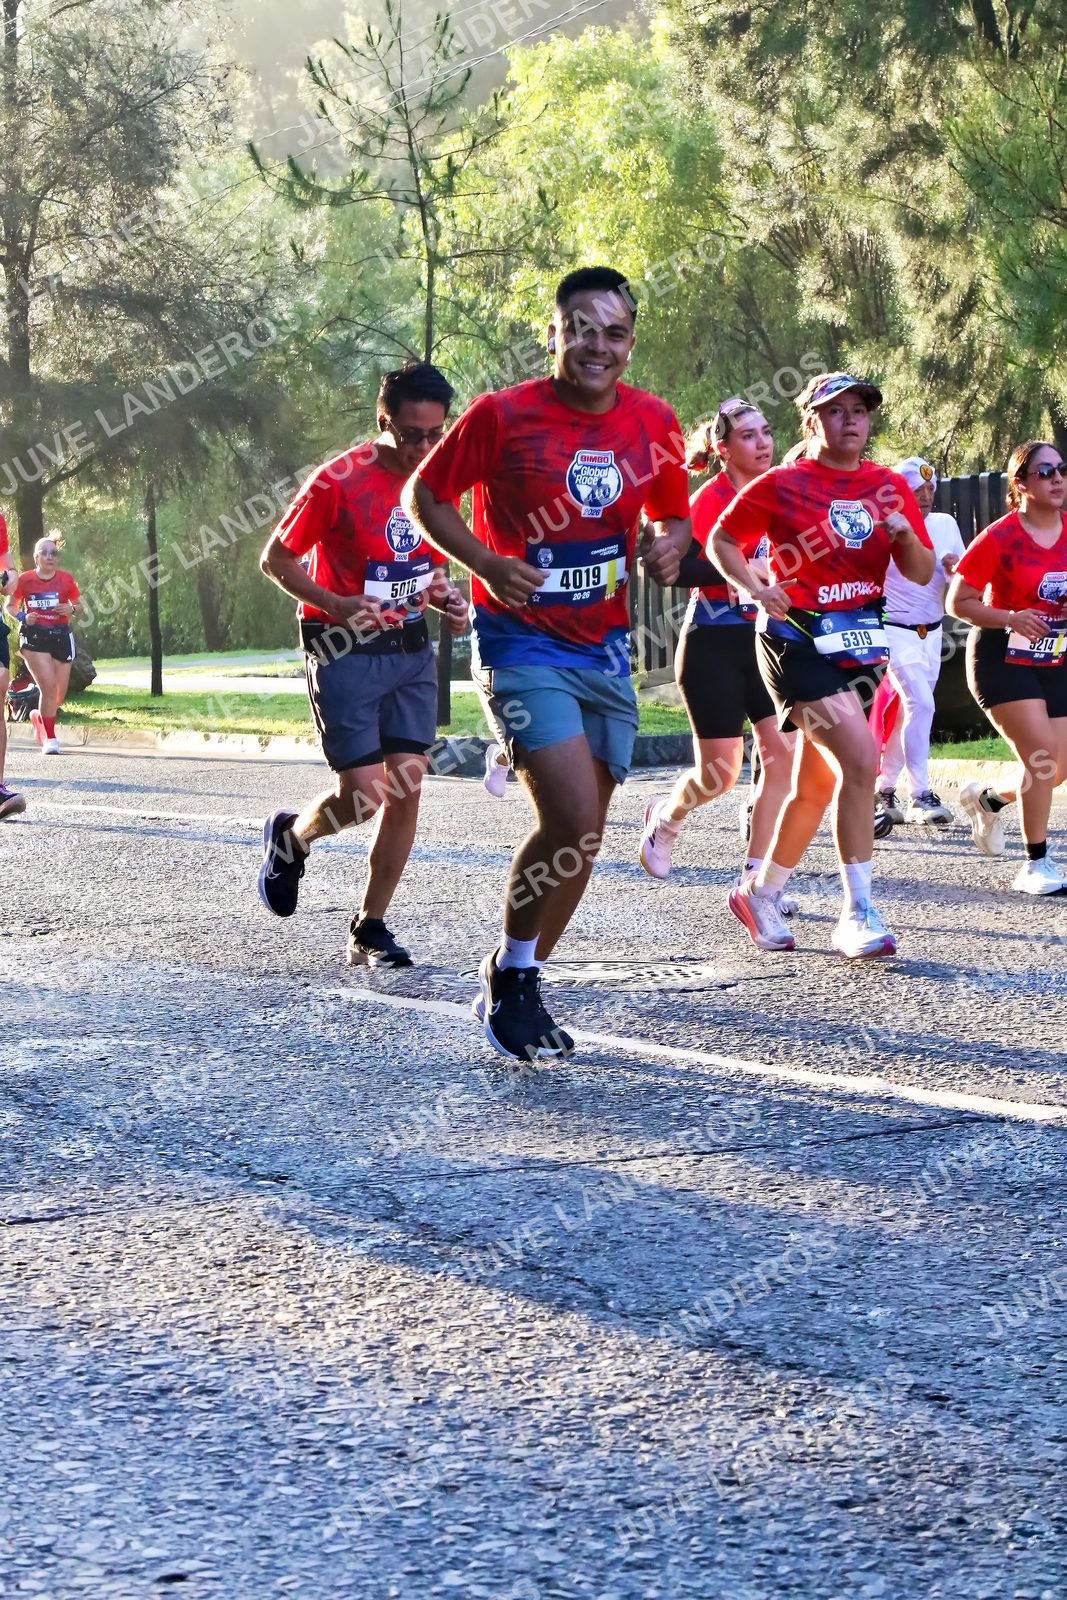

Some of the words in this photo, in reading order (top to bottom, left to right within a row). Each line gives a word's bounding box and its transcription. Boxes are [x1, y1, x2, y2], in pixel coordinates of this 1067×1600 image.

[580, 455, 609, 463] BIMBO
[581, 466, 609, 477] Global
[575, 475, 599, 485] Race
[583, 508, 601, 516] 2026
[560, 566, 601, 590] 4019
[390, 579, 417, 598] 5016
[841, 631, 872, 649] 5319
